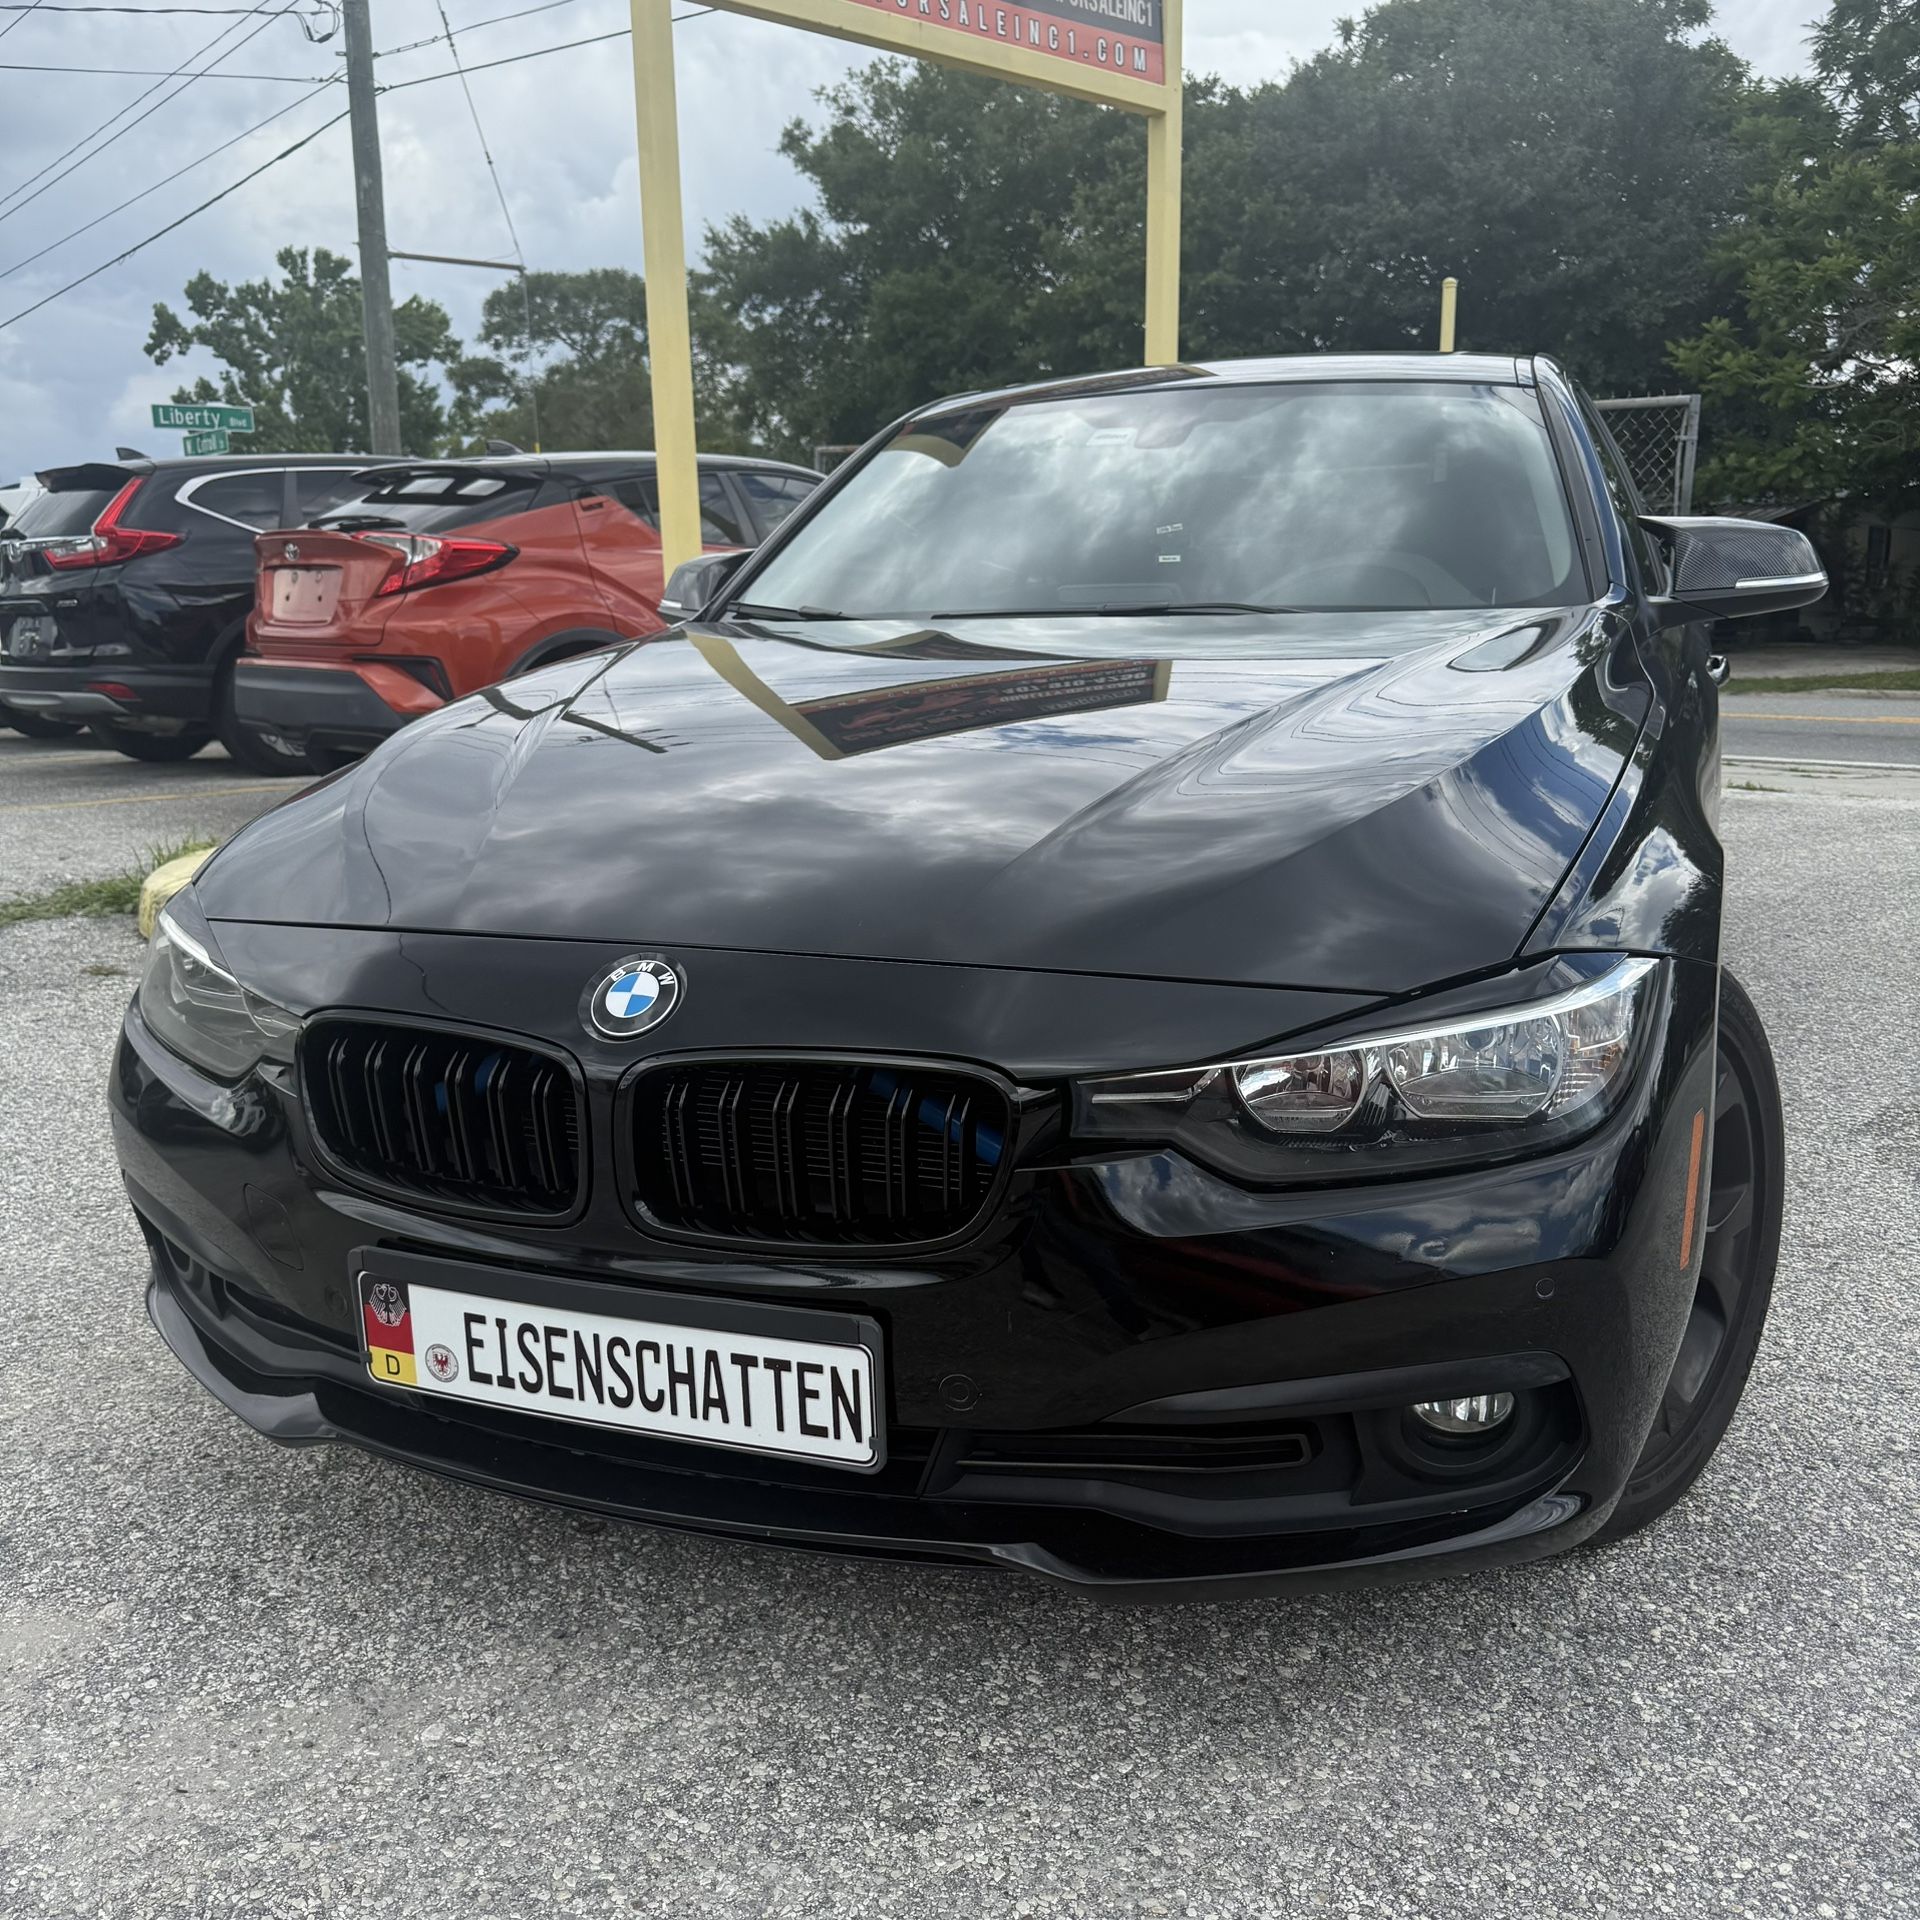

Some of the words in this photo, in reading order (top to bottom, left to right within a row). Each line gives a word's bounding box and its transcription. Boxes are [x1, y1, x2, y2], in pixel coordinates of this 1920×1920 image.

[1068, 0, 1153, 27] SALEINC1
[159, 407, 220, 429] Liberty
[610, 962, 675, 986] BMW
[385, 1354, 400, 1375] D
[463, 1312, 863, 1443] EISENSCHATTEN
